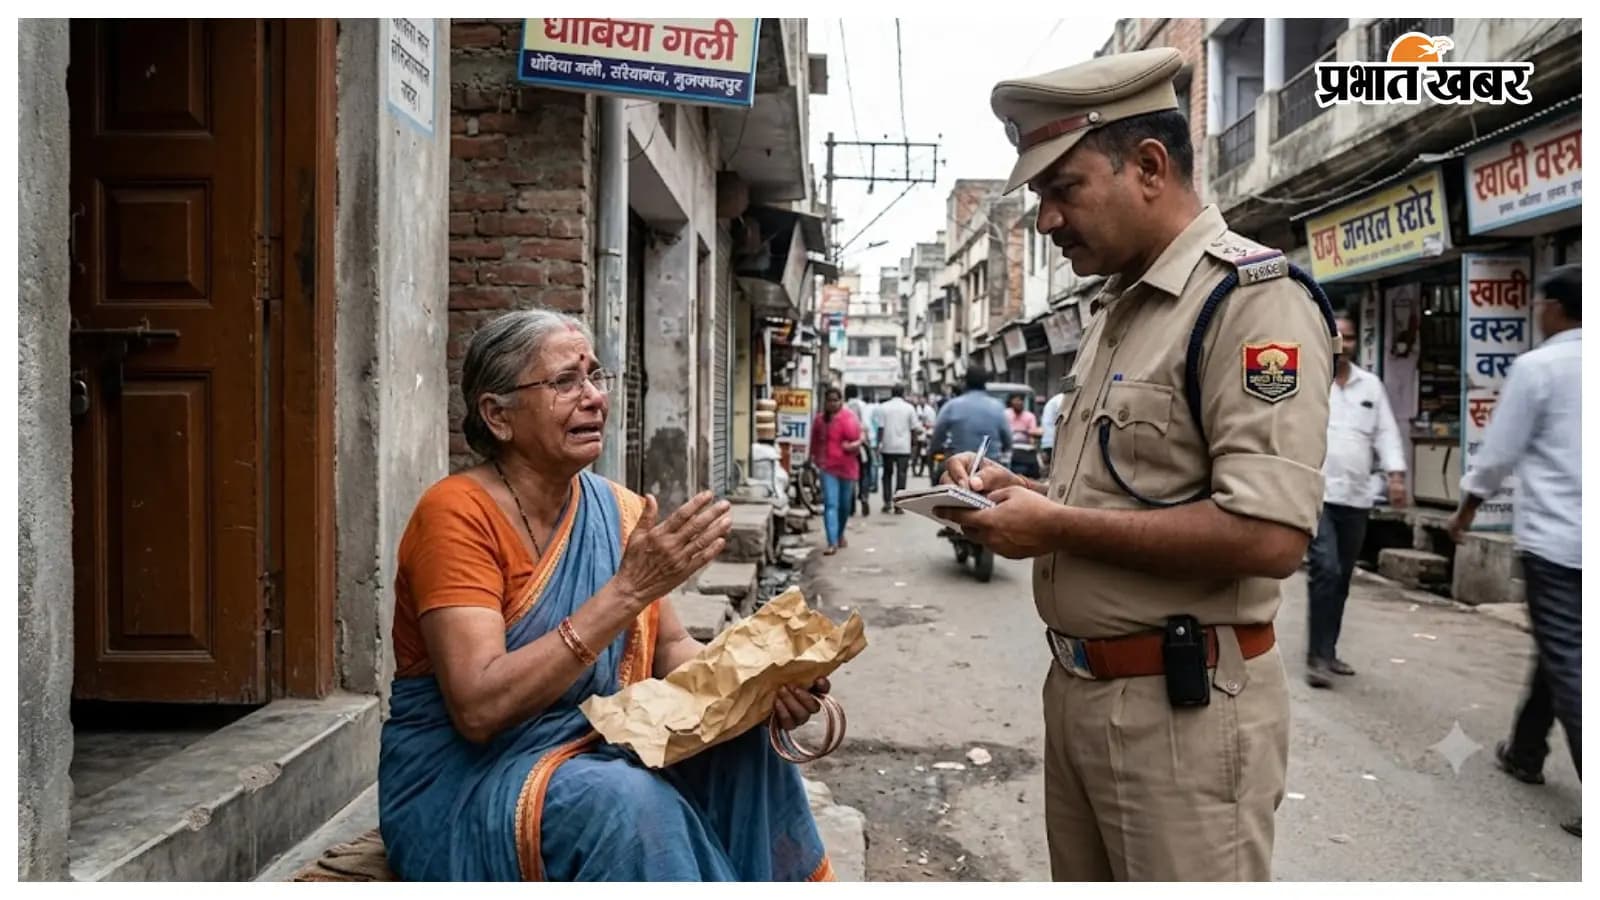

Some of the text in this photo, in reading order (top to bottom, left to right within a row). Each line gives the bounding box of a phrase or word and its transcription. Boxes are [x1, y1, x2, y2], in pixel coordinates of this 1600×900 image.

[662, 18, 738, 61] गली
[1474, 141, 1528, 201] खादी
[1311, 225, 1343, 267] राजू
[1340, 206, 1393, 250] जनरल
[1394, 184, 1436, 234] स्टोर
[1469, 269, 1528, 309] खादी
[1469, 317, 1527, 343] वस्त्र
